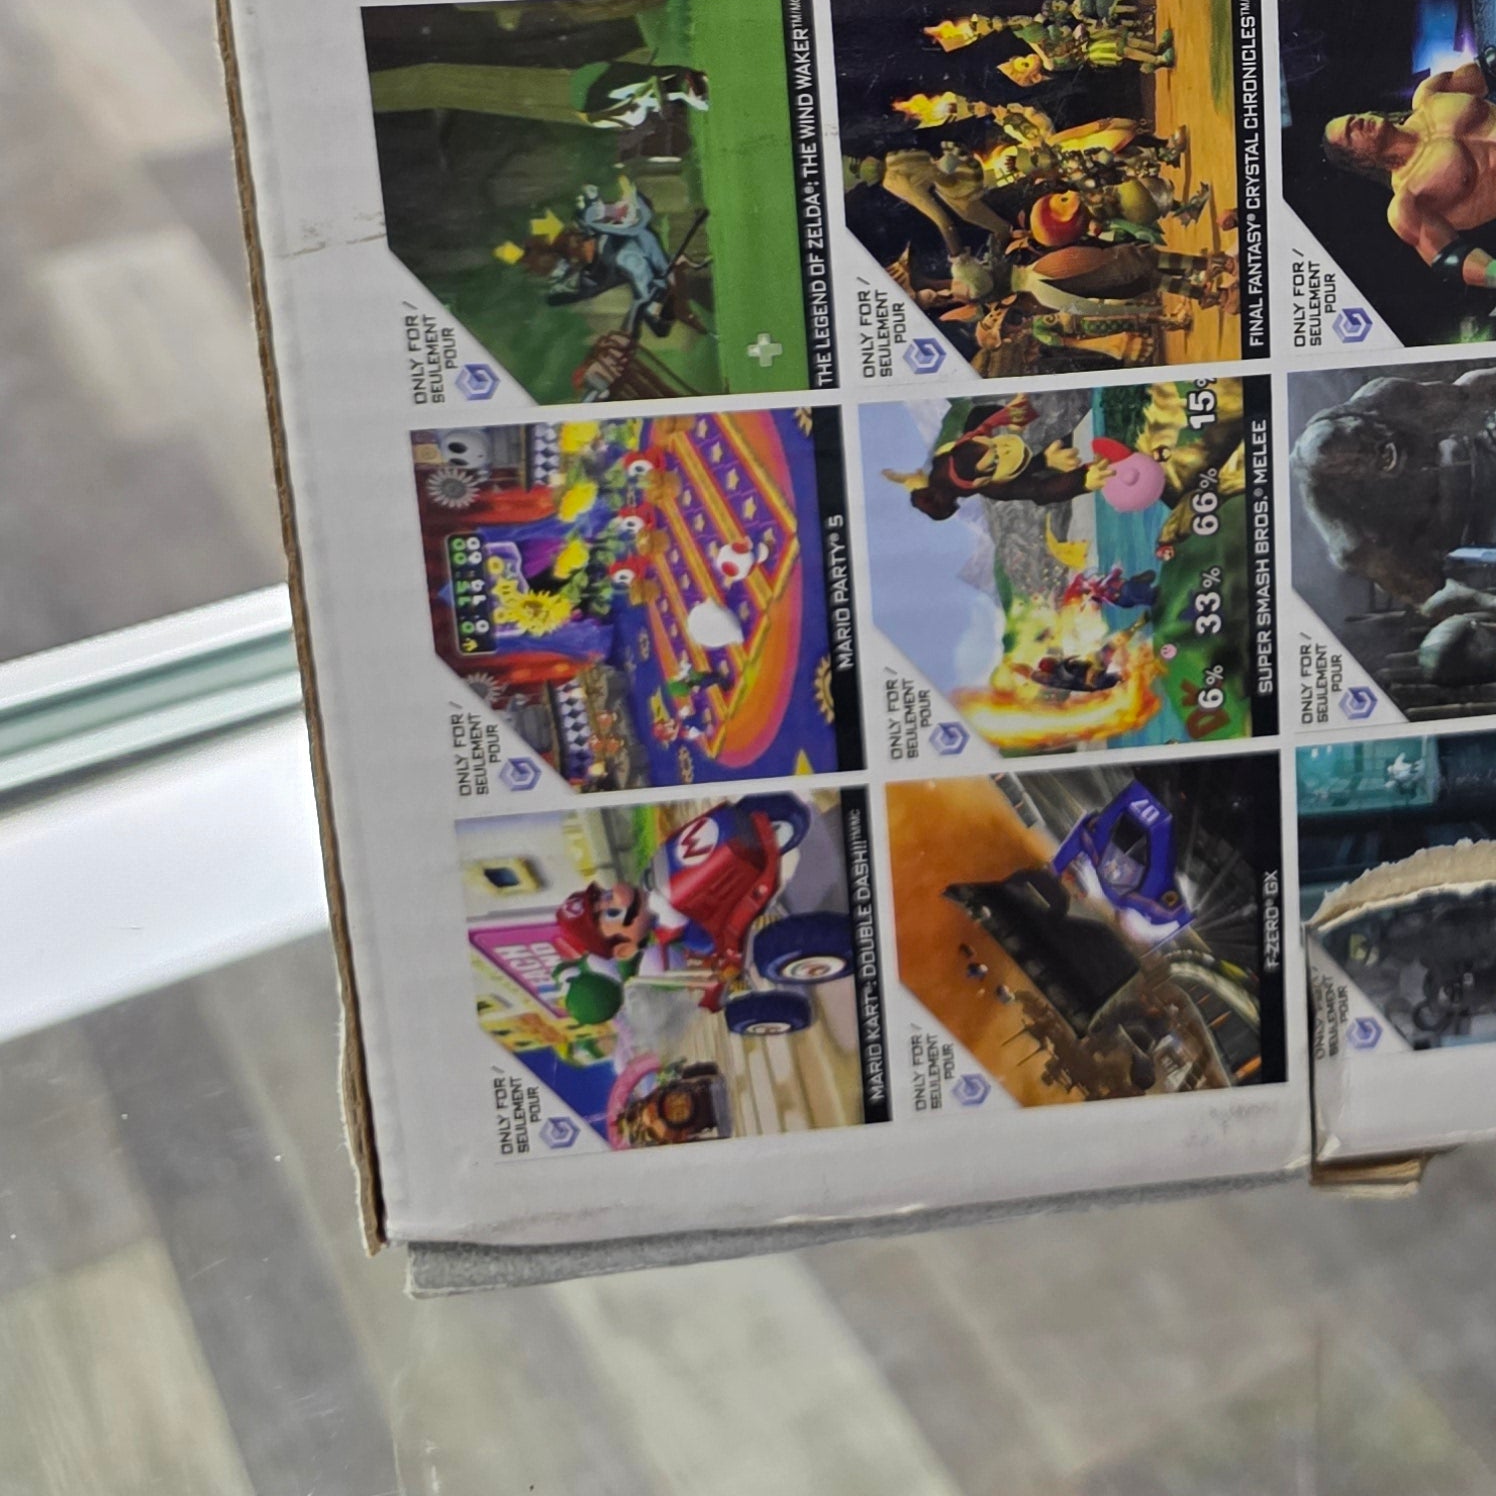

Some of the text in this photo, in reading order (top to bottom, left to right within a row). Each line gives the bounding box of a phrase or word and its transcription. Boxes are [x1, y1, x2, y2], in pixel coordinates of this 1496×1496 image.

[797, 92, 816, 140] WIND
[800, 142, 819, 179] THE
[1243, 132, 1261, 210] CRYSTAL
[808, 252, 826, 277] OF
[810, 279, 831, 349] LEGEND
[1248, 297, 1265, 347] FINAL
[815, 352, 833, 387] THE
[1251, 419, 1268, 485] MELEE
[827, 514, 844, 528] 5
[1255, 558, 1272, 627] SMASH
[834, 607, 854, 670] MARIO
[1256, 630, 1273, 694] SUPER
[857, 904, 885, 1101] MARIO DOUBLE
